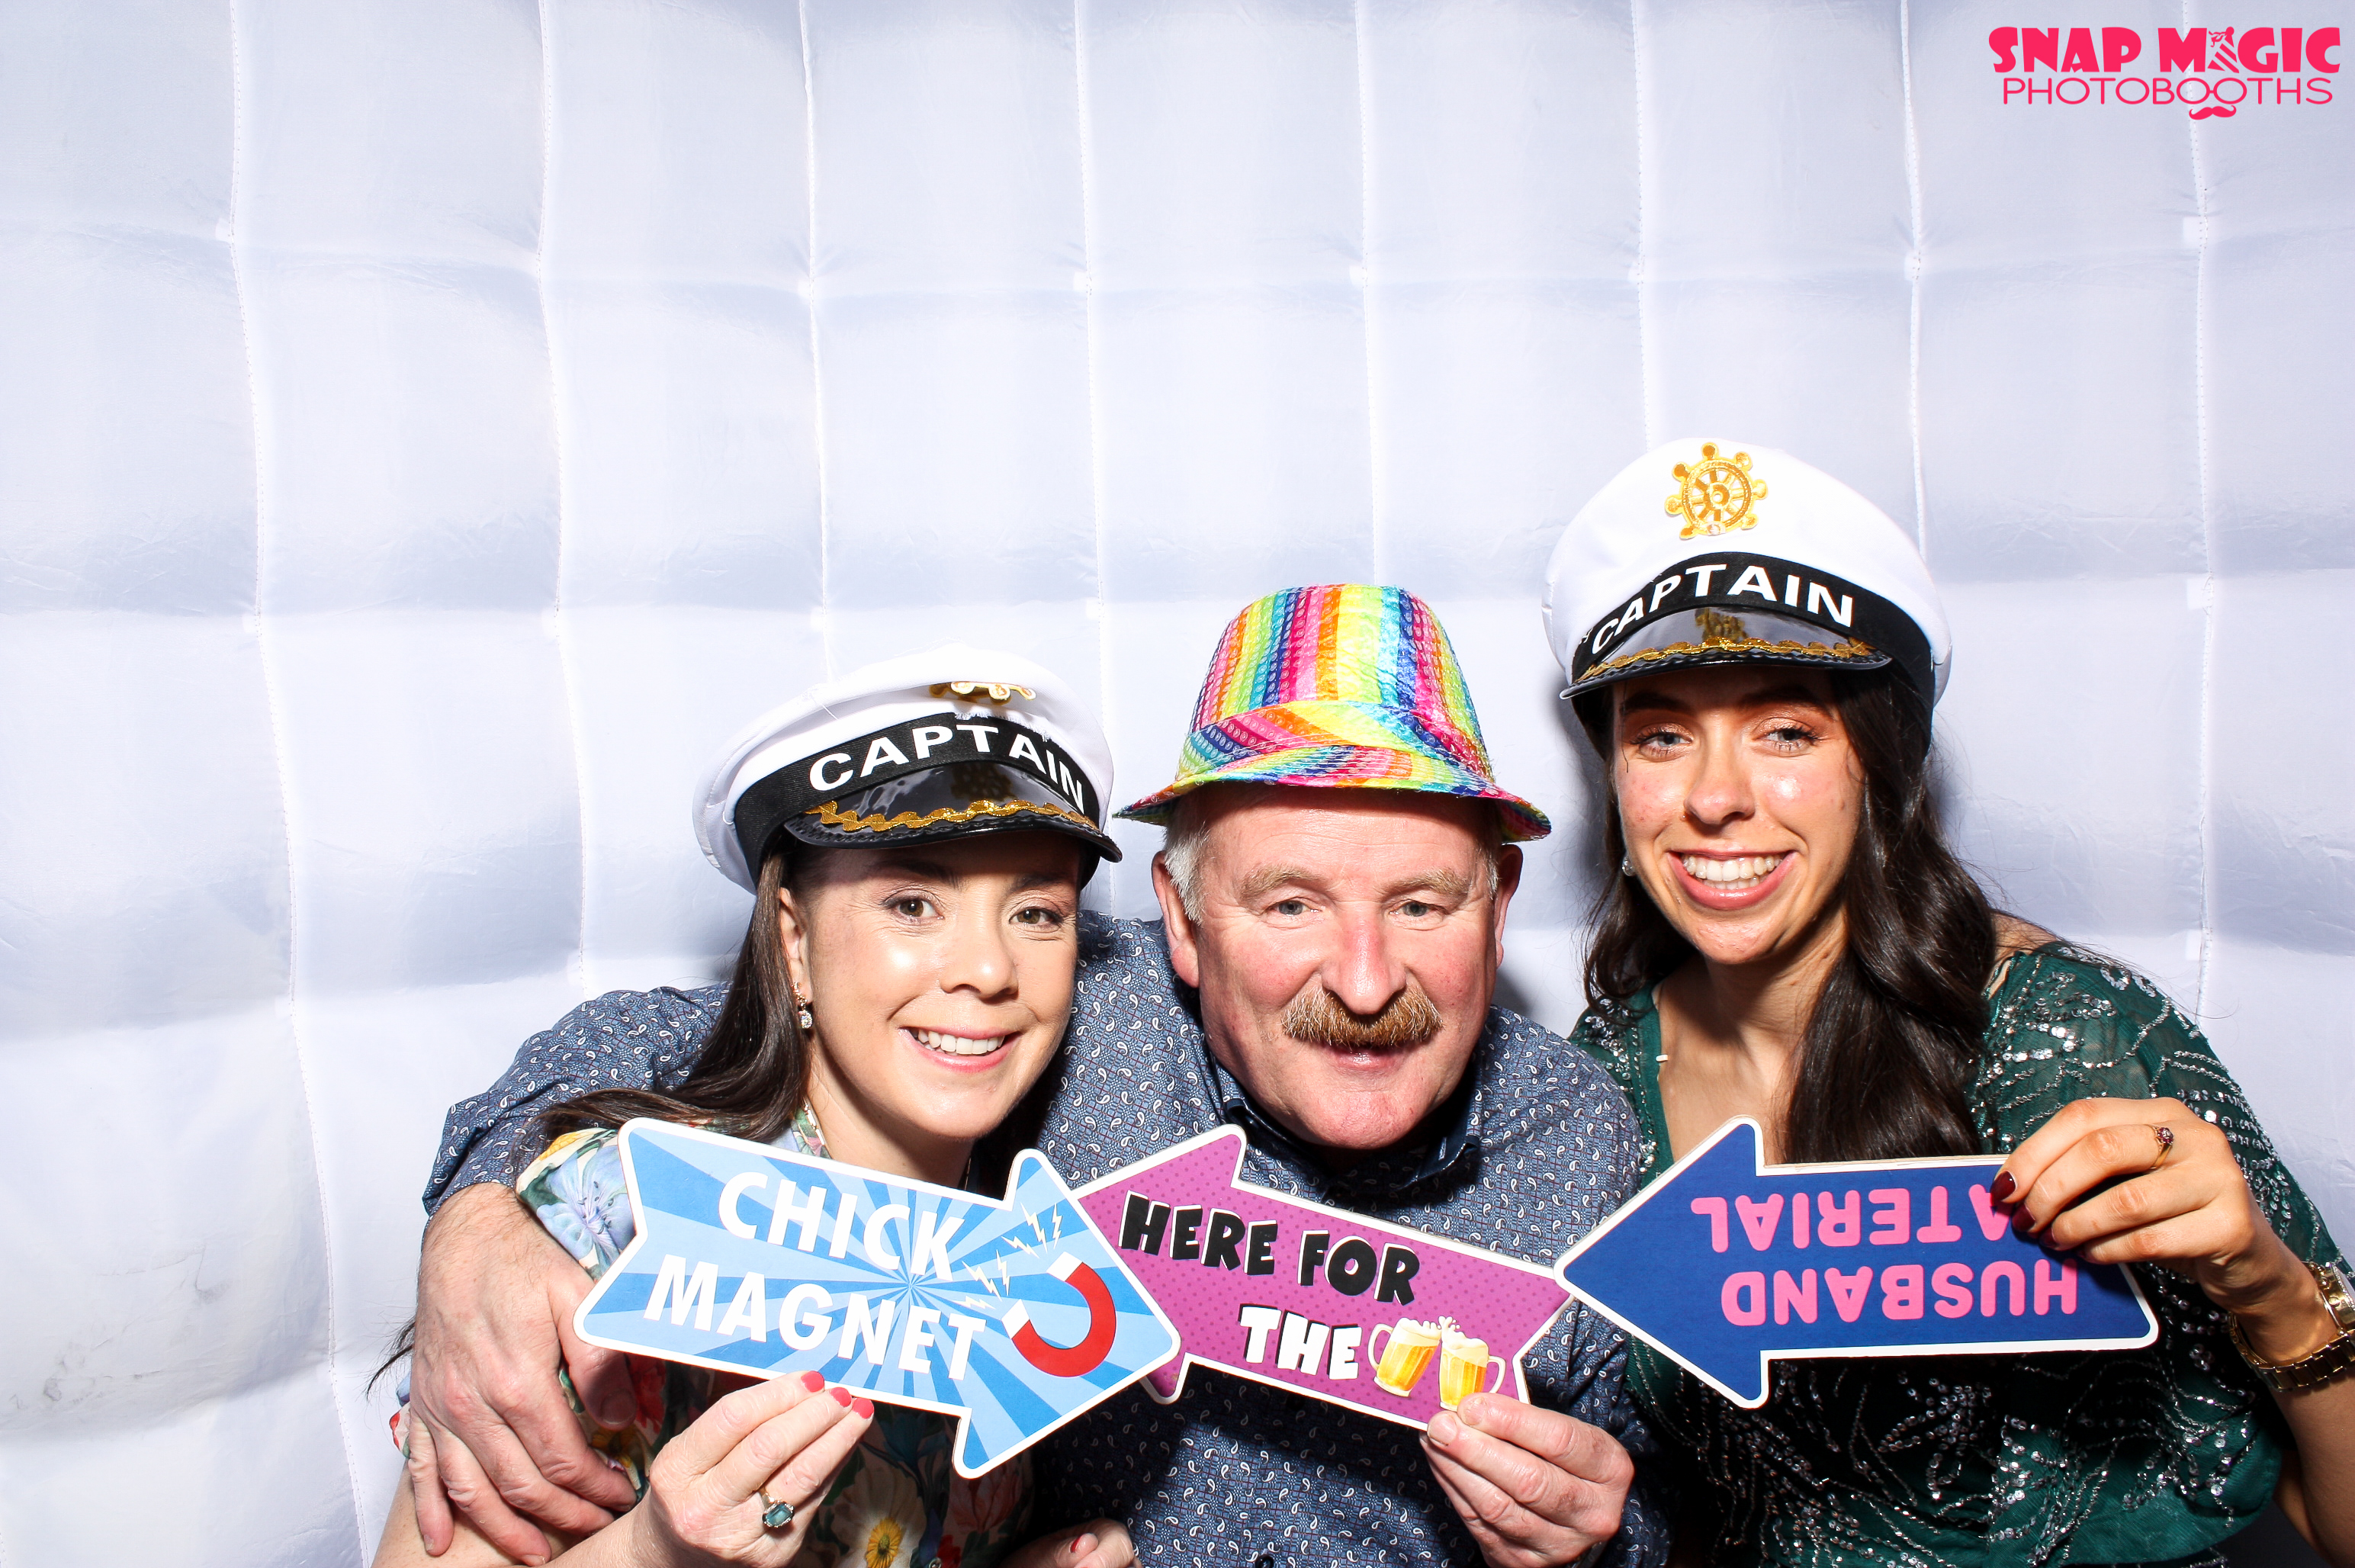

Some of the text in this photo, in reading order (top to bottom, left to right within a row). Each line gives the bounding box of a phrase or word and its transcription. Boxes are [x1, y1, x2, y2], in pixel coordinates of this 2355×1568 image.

[1592, 564, 1853, 654] CAPTAIN
[809, 725, 1084, 815] CAPTAIN
[718, 1171, 965, 1281] CHICK
[1119, 1190, 1420, 1306] HERE FOR
[1691, 1185, 2010, 1252] ATERIAL
[644, 1254, 986, 1380] MAGNET
[1720, 1258, 2078, 1326] HUSBAND
[1239, 1304, 1362, 1380] THE
